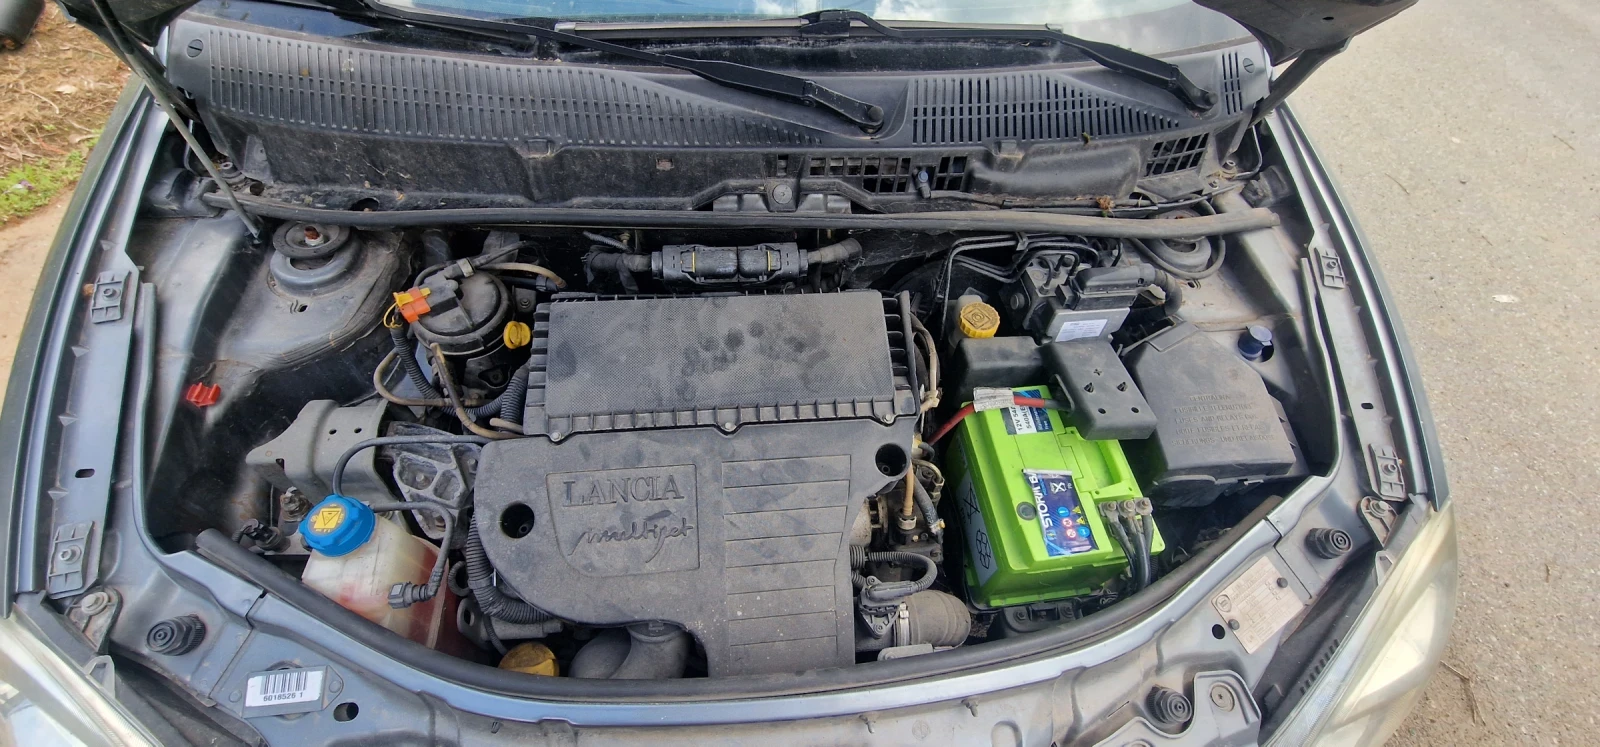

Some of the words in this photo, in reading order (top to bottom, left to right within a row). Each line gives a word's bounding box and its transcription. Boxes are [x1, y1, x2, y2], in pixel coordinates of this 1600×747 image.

[1216, 414, 1243, 422] RELAYS
[1015, 419, 1023, 430] 12V
[562, 474, 685, 507] LANCIA
[1033, 486, 1053, 527] STORM
[263, 693, 296, 702] 6018526
